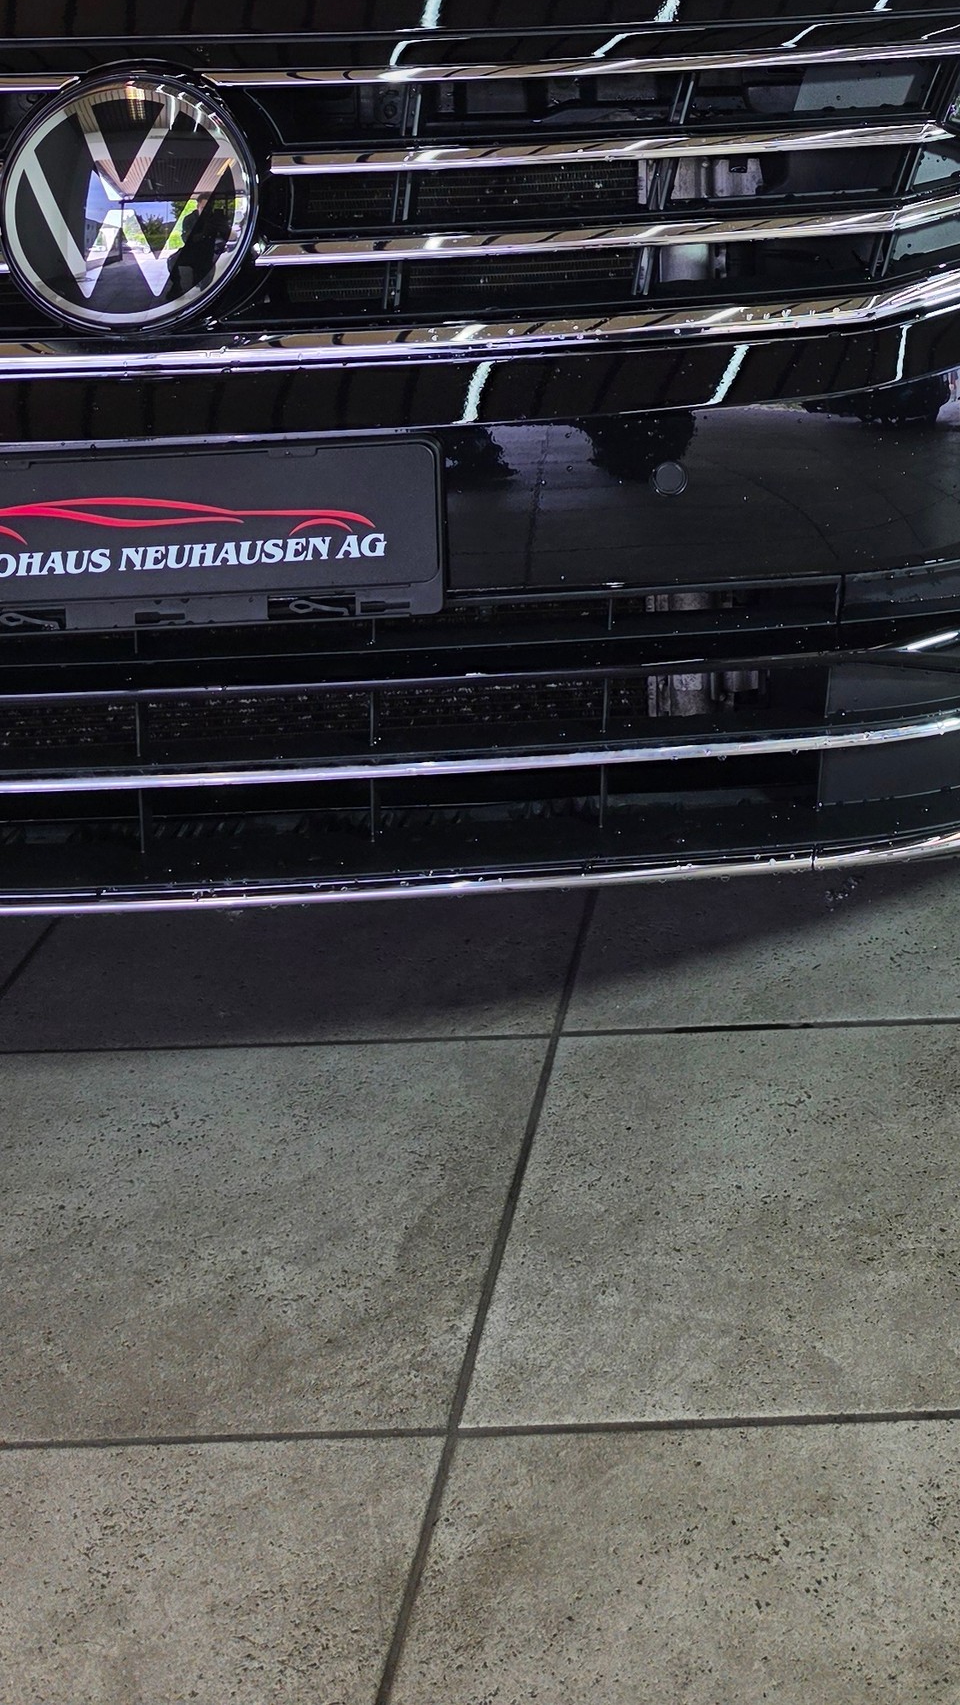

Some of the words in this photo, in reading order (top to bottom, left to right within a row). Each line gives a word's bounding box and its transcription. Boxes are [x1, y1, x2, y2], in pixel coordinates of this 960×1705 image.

[10, 89, 246, 319] VW
[117, 536, 332, 571] NEUHAUSEN
[334, 533, 388, 559] AG
